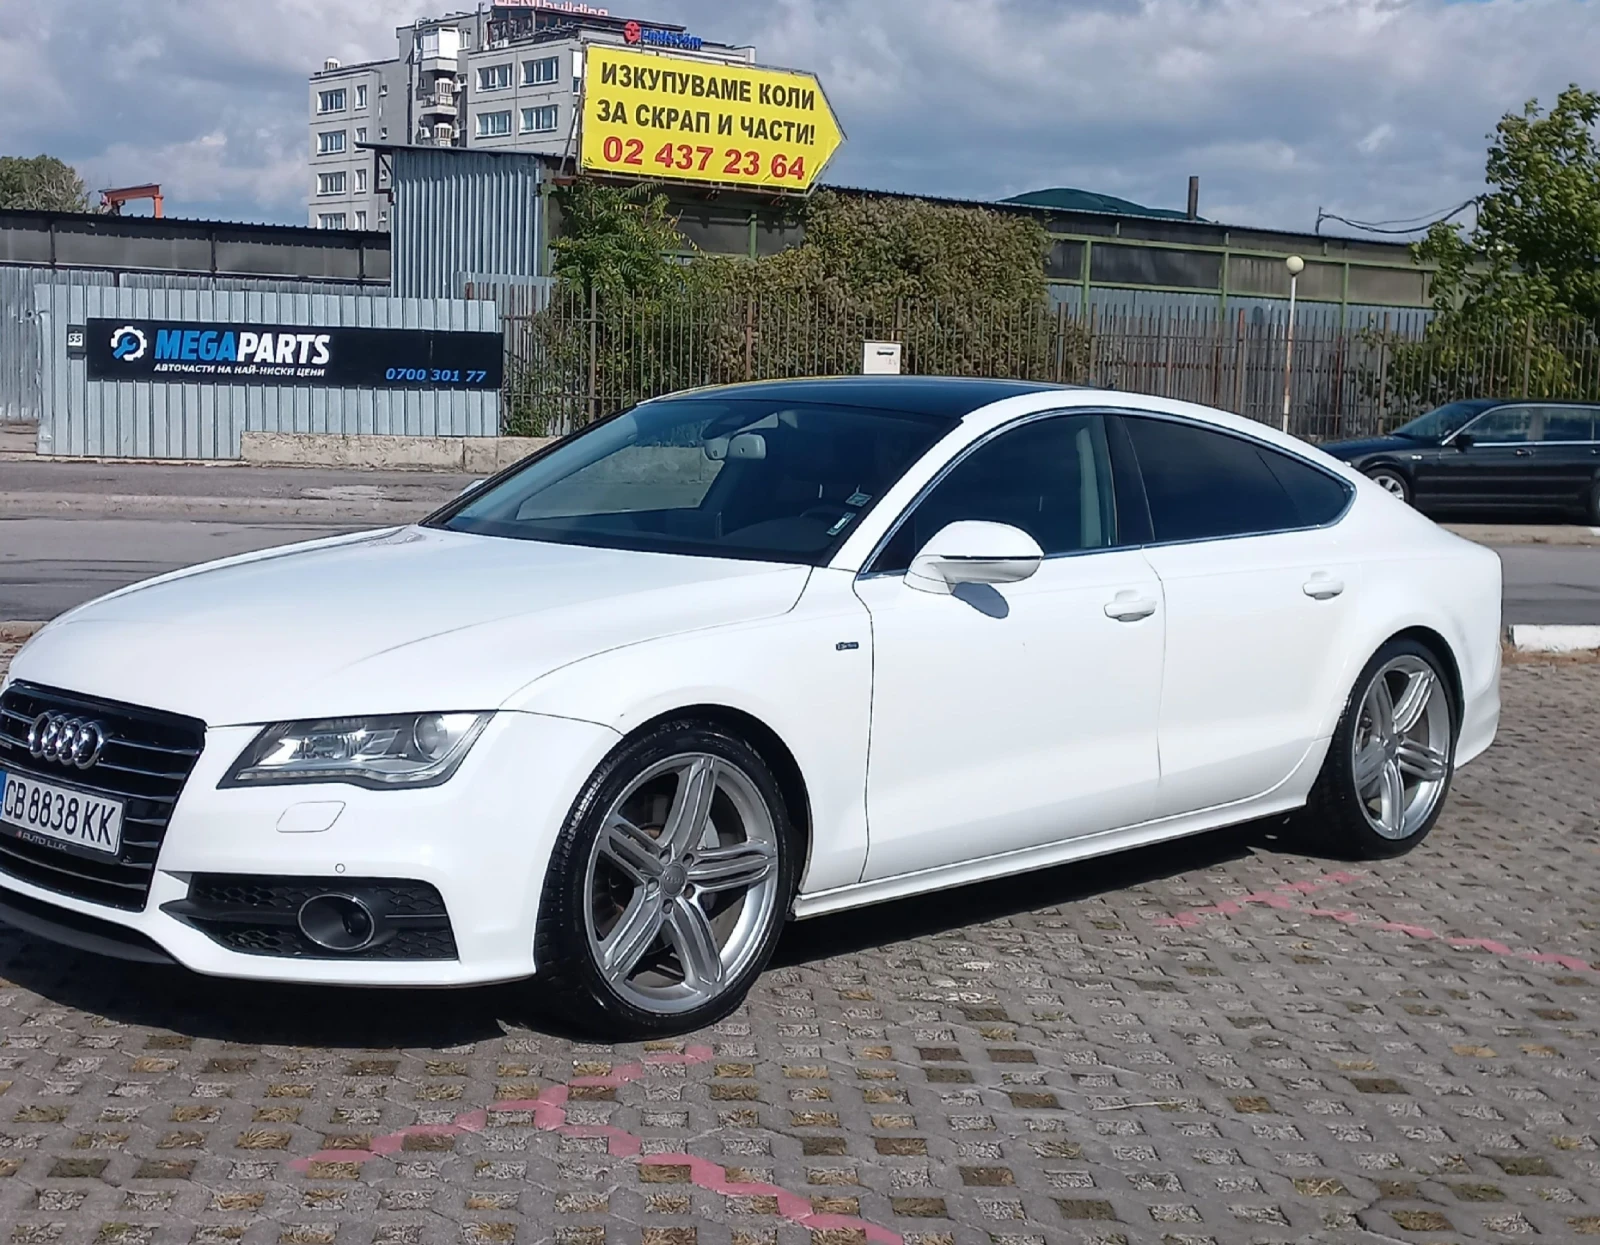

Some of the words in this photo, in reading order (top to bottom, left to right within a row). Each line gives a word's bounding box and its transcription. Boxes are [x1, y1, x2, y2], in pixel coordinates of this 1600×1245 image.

[601, 62, 751, 102] ИЗКУПУВАМЕ
[759, 83, 815, 110] КОЛИ
[597, 100, 627, 124] ЗА
[635, 104, 710, 133] СКРАП
[718, 114, 732, 136] И
[741, 116, 815, 145] ЧАСТИ!
[603, 136, 644, 165] 02
[655, 143, 713, 171] 437
[723, 149, 760, 176] 23
[771, 154, 805, 180] 64
[154, 329, 331, 365] MEGAPARTS
[154, 363, 215, 374] АВТОЧАСТИ
[217, 365, 232, 374] НА
[234, 365, 294, 376] НАЙ-НИСКИ
[297, 367, 325, 378] ЦЕНИ
[385, 368, 427, 380] 0700
[431, 369, 460, 382] 301
[465, 370, 487, 383] 77
[28, 787, 80, 836] 8838
[23, 833, 46, 845] AUTO
[47, 839, 68, 852] LUX
